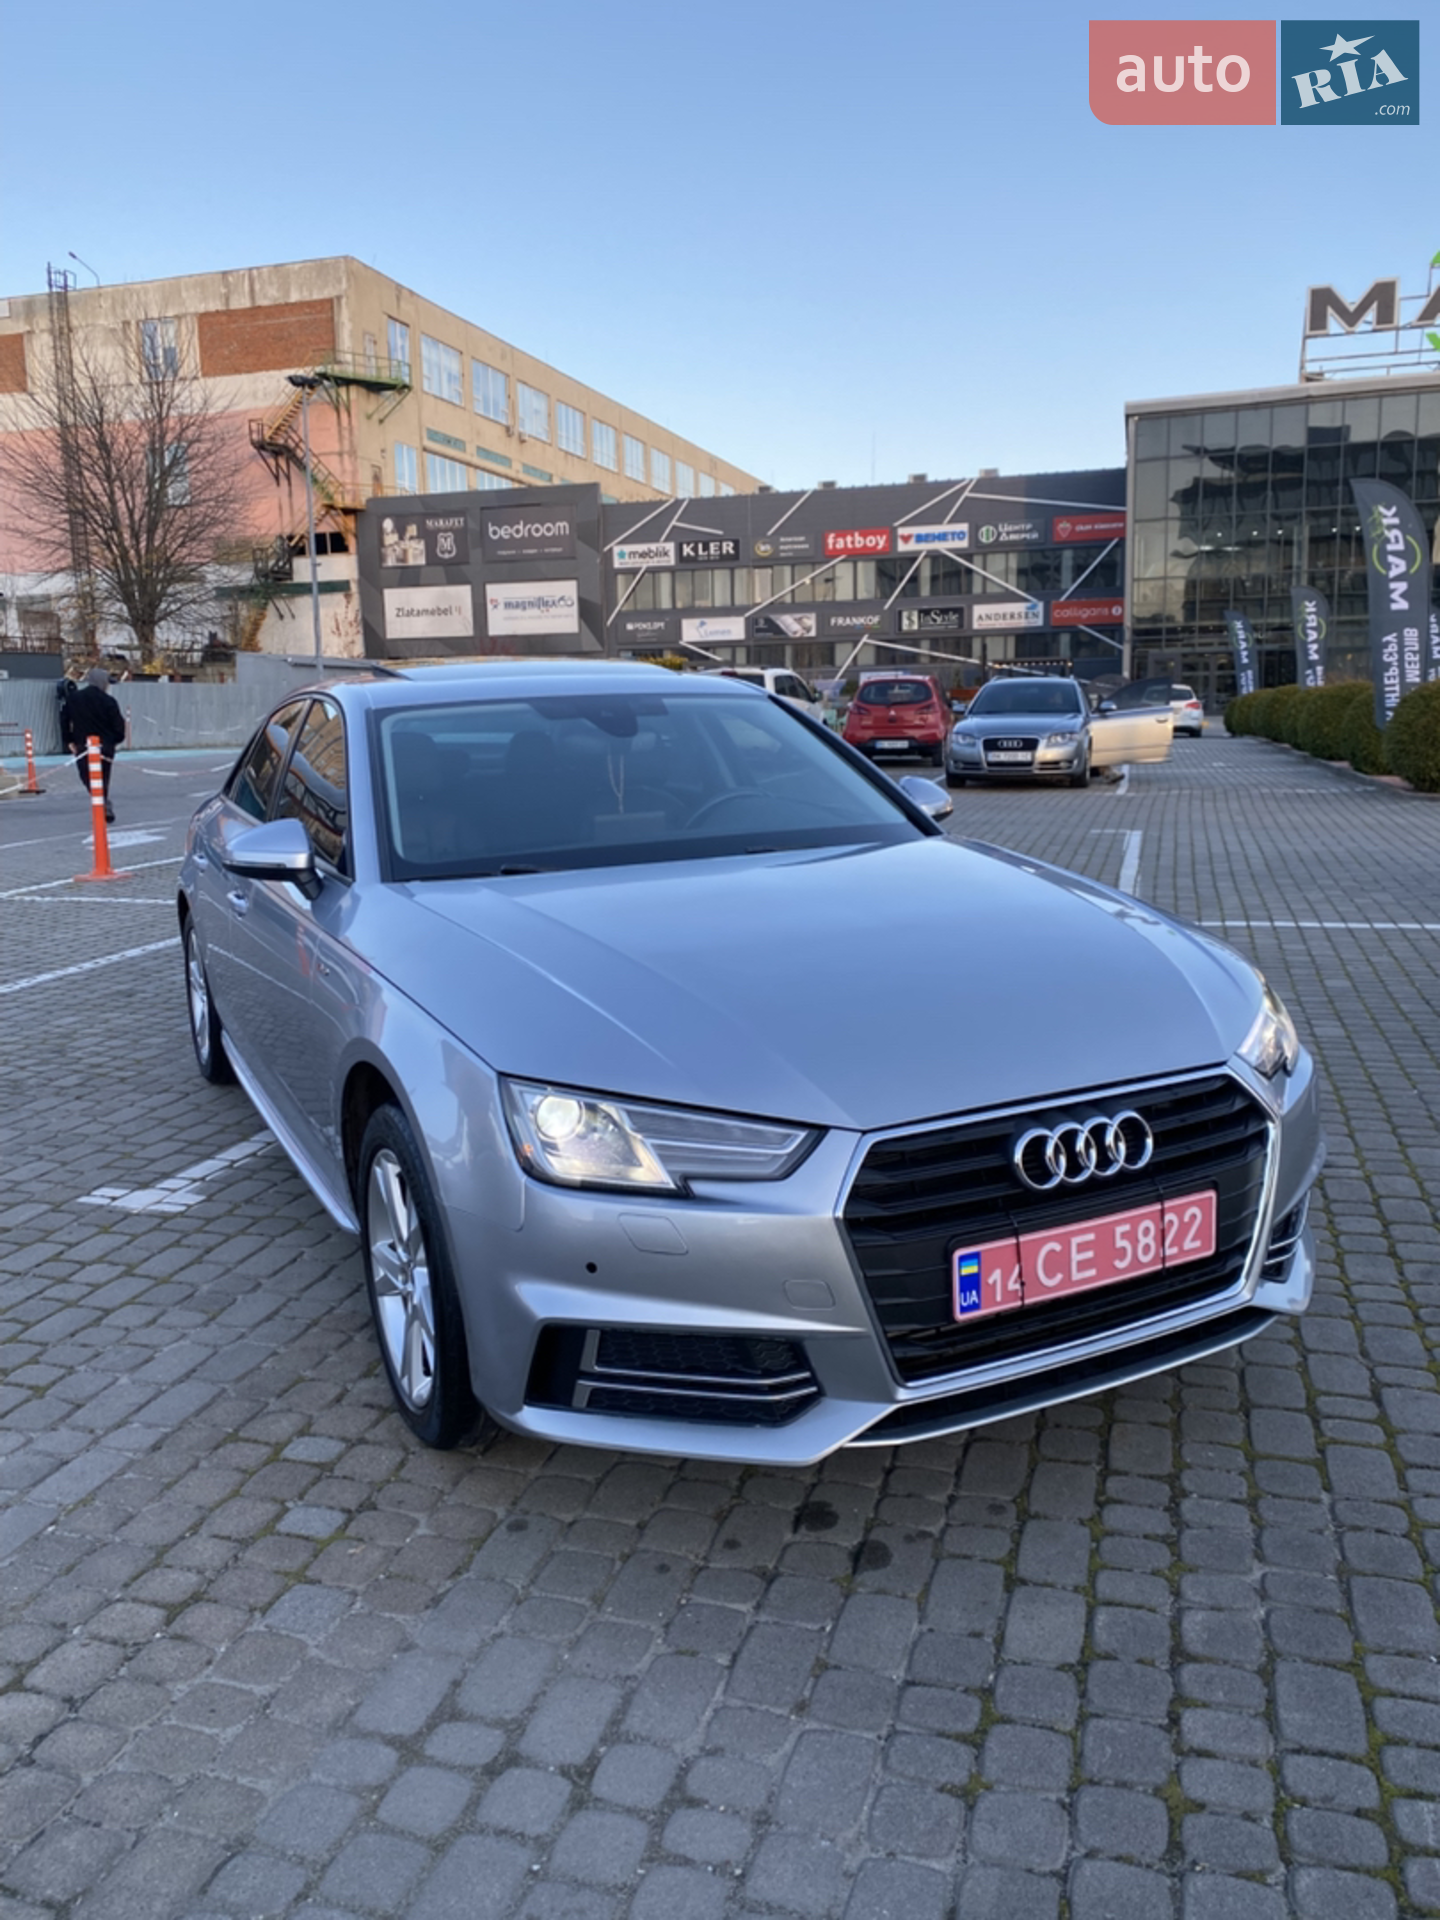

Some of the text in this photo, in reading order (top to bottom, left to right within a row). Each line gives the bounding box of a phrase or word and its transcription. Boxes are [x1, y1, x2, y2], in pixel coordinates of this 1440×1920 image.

[488, 519, 570, 540] bedroom
[827, 531, 887, 550] fatboy
[628, 546, 670, 559] meblik
[682, 541, 735, 557] KLER
[395, 605, 453, 618] Zlatamebel
[976, 610, 1040, 622] ANDERSEN
[830, 614, 881, 626] FRANKOF
[1036, 1233, 1097, 1288] CE
[1112, 1206, 1202, 1270] 5822
[961, 1292, 979, 1307] UA
